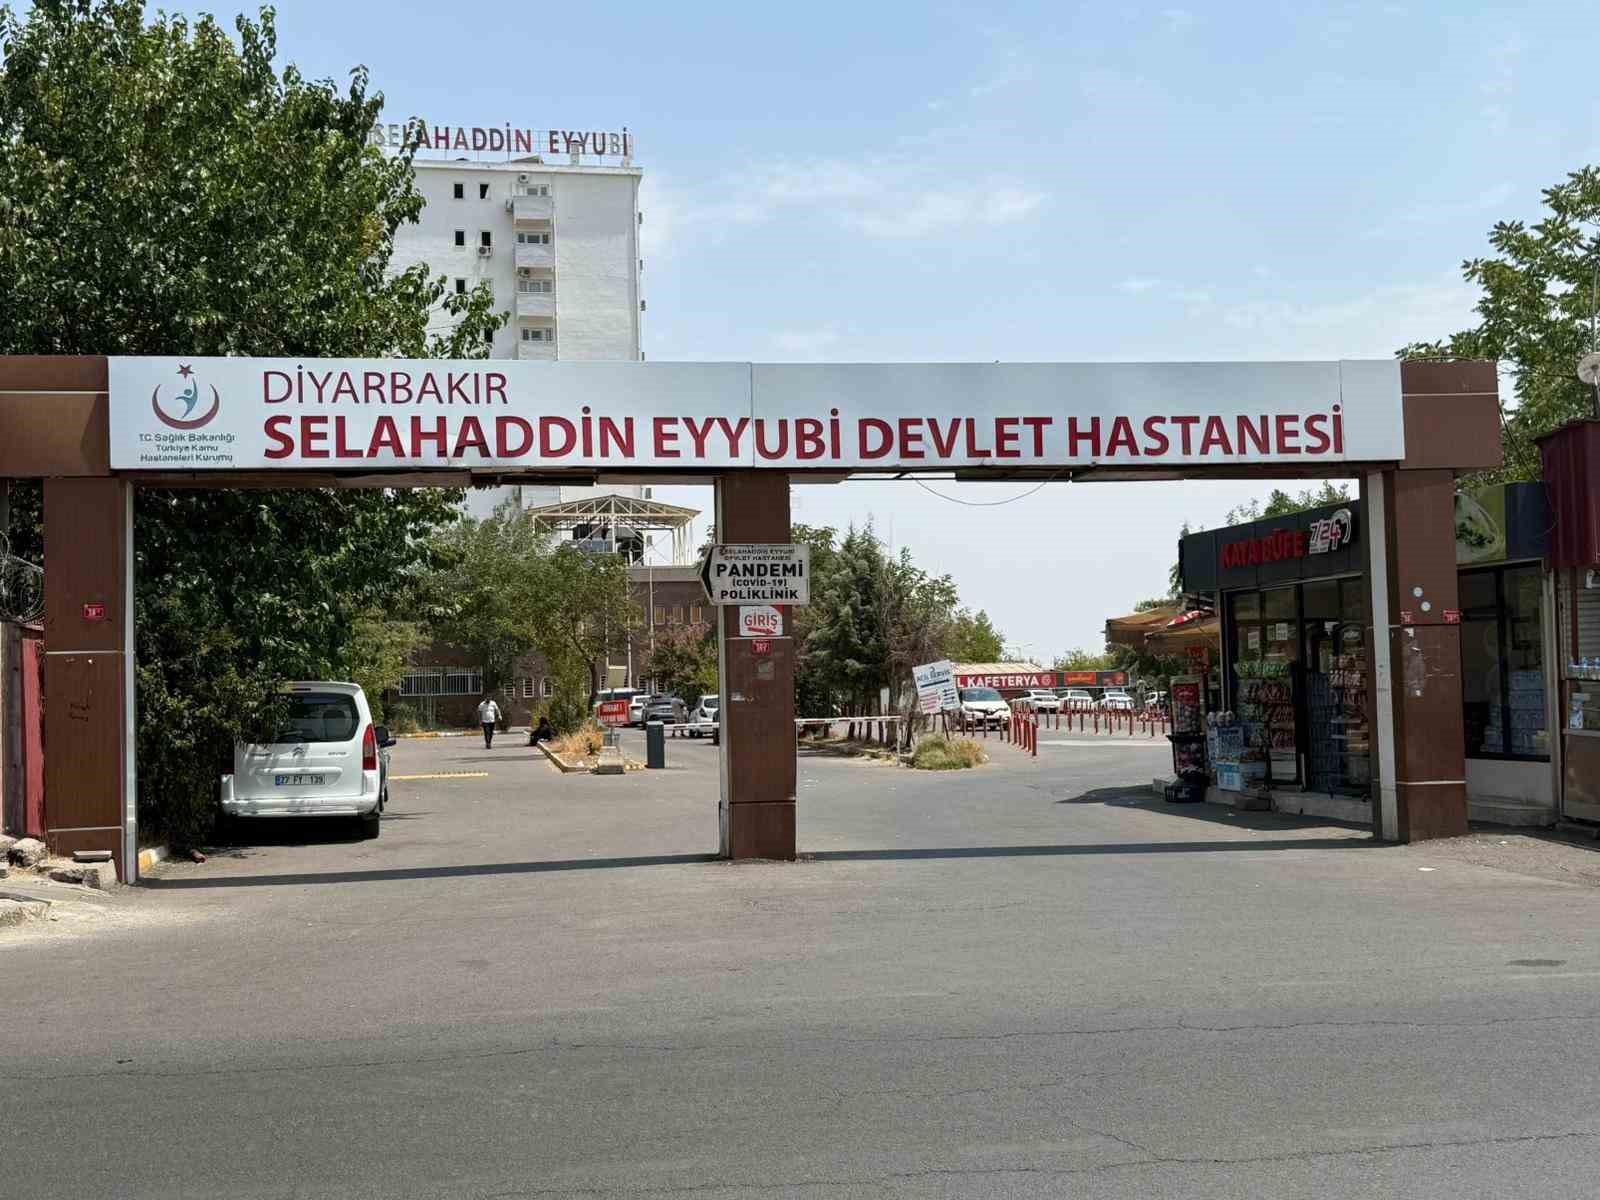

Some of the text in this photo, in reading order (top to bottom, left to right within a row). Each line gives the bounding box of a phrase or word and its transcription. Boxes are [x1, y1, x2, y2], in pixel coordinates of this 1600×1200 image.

[549, 126, 627, 157] EYYUBİ
[263, 364, 508, 405] DİYARBAKIR
[154, 433, 186, 443] Sağlık
[188, 433, 235, 443] Bakanlığı
[263, 403, 1345, 461] SELAHADDİN EYYUBİ DEVLET HASTANESİ
[191, 444, 218, 452] Kamu
[716, 559, 803, 577] PANDEMİ
[720, 587, 799, 600] POLİKLİNİK
[744, 612, 778, 629] GİRİŞ
[967, 675, 1039, 688] KAFETERYA
